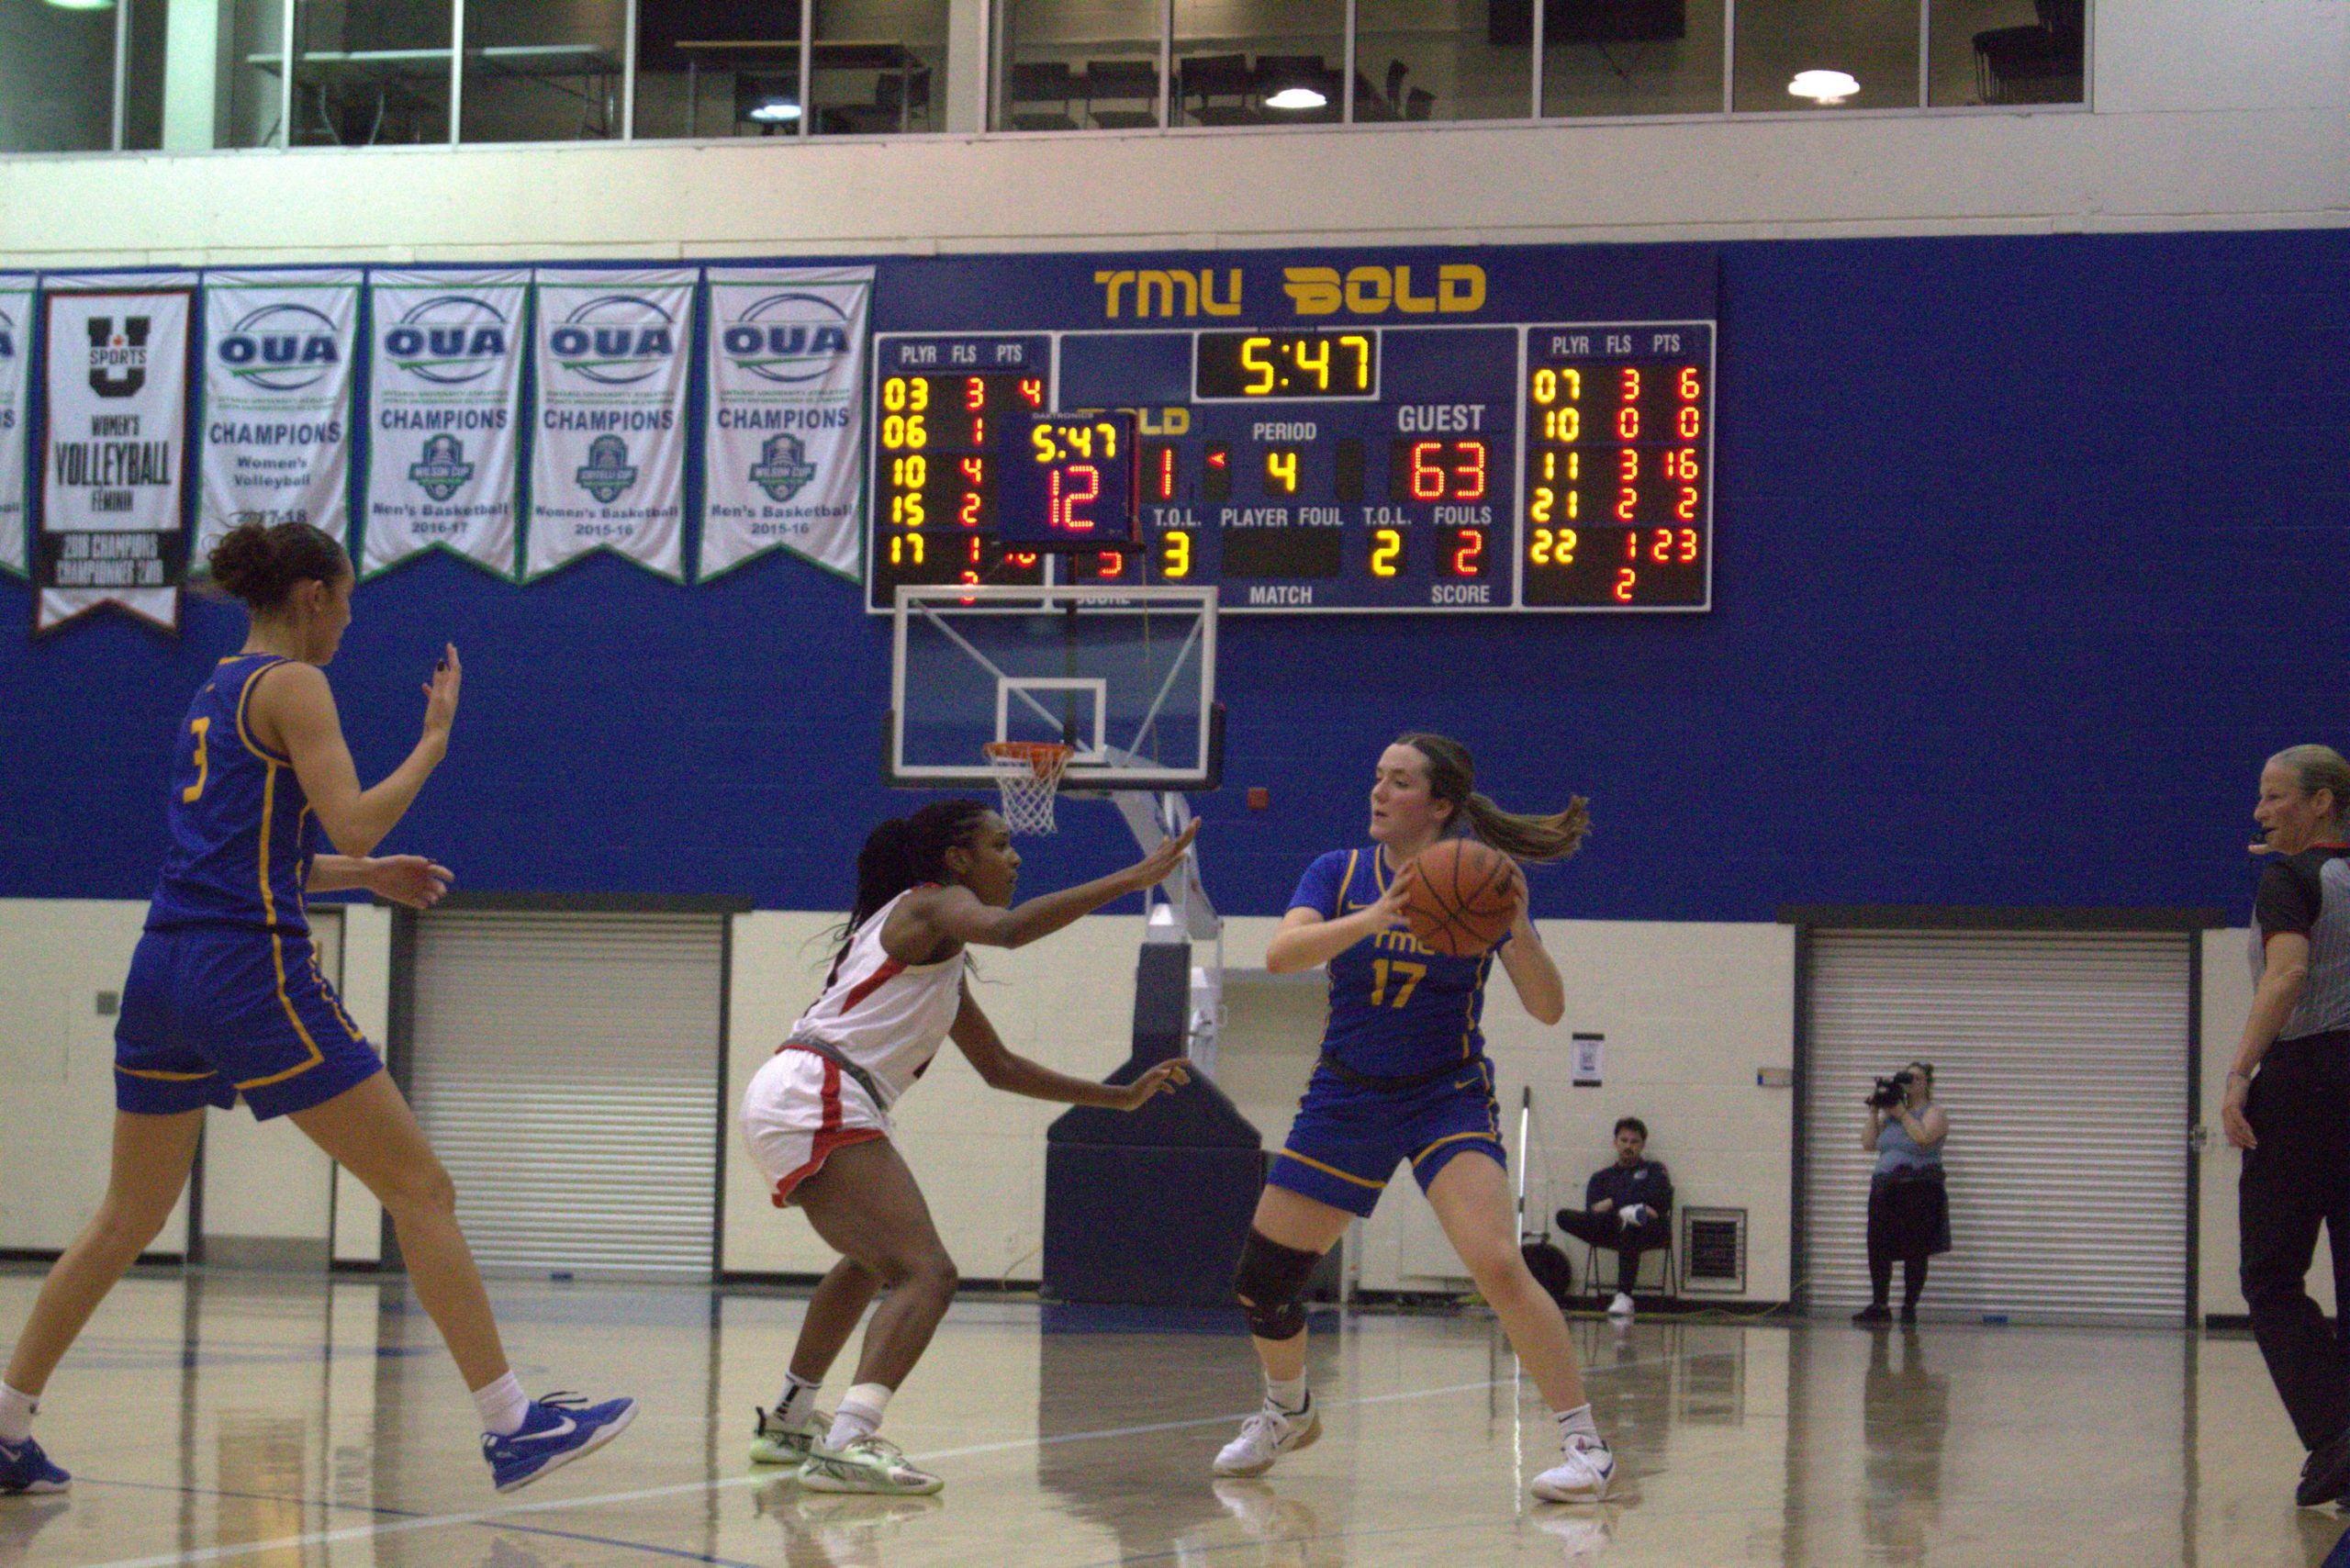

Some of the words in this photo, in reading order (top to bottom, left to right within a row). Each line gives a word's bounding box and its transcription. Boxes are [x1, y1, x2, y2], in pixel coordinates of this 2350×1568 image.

[1094, 269, 1242, 318] TMU
[1284, 264, 1486, 315] BOLD
[219, 335, 339, 363] OUA
[385, 329, 505, 356] OUA
[552, 328, 673, 356] OUA
[722, 326, 849, 354] OUA
[901, 346, 936, 364] PLYR
[952, 345, 977, 363] FLS
[997, 344, 1022, 362] PTS
[1552, 337, 1589, 353] PLYR
[1607, 335, 1631, 353] FLS
[1654, 334, 1681, 352] PTS
[90, 349, 147, 364] SPORTS
[1242, 337, 1368, 394] 5:47
[884, 377, 928, 411] 03
[967, 377, 983, 409] 3
[1021, 378, 1040, 405] 4
[1534, 369, 1580, 403] 07
[1623, 369, 1639, 399] 3
[1681, 368, 1699, 398] 6
[92, 415, 139, 436] WOMEN'S
[210, 420, 341, 444] CHAMPIONS
[381, 409, 508, 430] CHAMPIONS
[544, 409, 673, 430] CHAMPIONS
[718, 408, 849, 429] CHAMPIONS
[883, 415, 926, 449] 06
[974, 417, 983, 445] 1
[1254, 422, 1316, 440] PERIOD
[1398, 405, 1485, 431] GUEST
[1545, 408, 1579, 442] 10
[1620, 407, 1639, 438] 0
[1680, 407, 1698, 437] 0
[1033, 422, 1115, 462] 5:47
[56, 442, 171, 485] VOLLEYBALL
[238, 457, 308, 468] Women's
[894, 454, 925, 488] 10
[965, 459, 981, 484] 4
[1270, 452, 1296, 491] 4
[1413, 441, 1485, 498] 63
[1545, 453, 1578, 480] 11
[1621, 449, 1638, 479] 3
[1667, 448, 1697, 479] 16
[234, 475, 310, 488] Volleyball
[374, 503, 416, 515] Men's
[422, 504, 508, 515] Basketball
[711, 504, 755, 517] Men's
[763, 505, 851, 518] Basketball
[892, 492, 924, 527] 15
[963, 493, 980, 524] 2
[1051, 465, 1099, 530] 12
[1532, 487, 1578, 521] 21
[1618, 487, 1637, 518] 2
[1679, 487, 1696, 518] 2
[535, 507, 596, 518] Women's
[602, 507, 677, 518] Basketball
[1155, 508, 1202, 527] T.O.L.
[1221, 510, 1287, 526] PLAYER
[1299, 509, 1343, 525] FOUL
[1365, 508, 1411, 524] T.O.L.
[1434, 506, 1492, 524] FOULS
[411, 522, 467, 532] 2016-17
[575, 523, 633, 535] 2015-16
[751, 523, 810, 534] 2015-16
[891, 532, 923, 565] 17
[970, 535, 979, 562] 1
[1166, 531, 1190, 577] 3
[1373, 530, 1401, 576] 2
[1456, 530, 1483, 575] 2
[1531, 529, 1577, 563] 22
[1628, 532, 1637, 558] 1
[1653, 529, 1696, 560] 23
[1250, 587, 1312, 603] MATCH
[1432, 586, 1490, 602] SCORE
[1617, 568, 1635, 599] 2
[184, 717, 209, 803] 3
[1371, 958, 1427, 1008] 17
